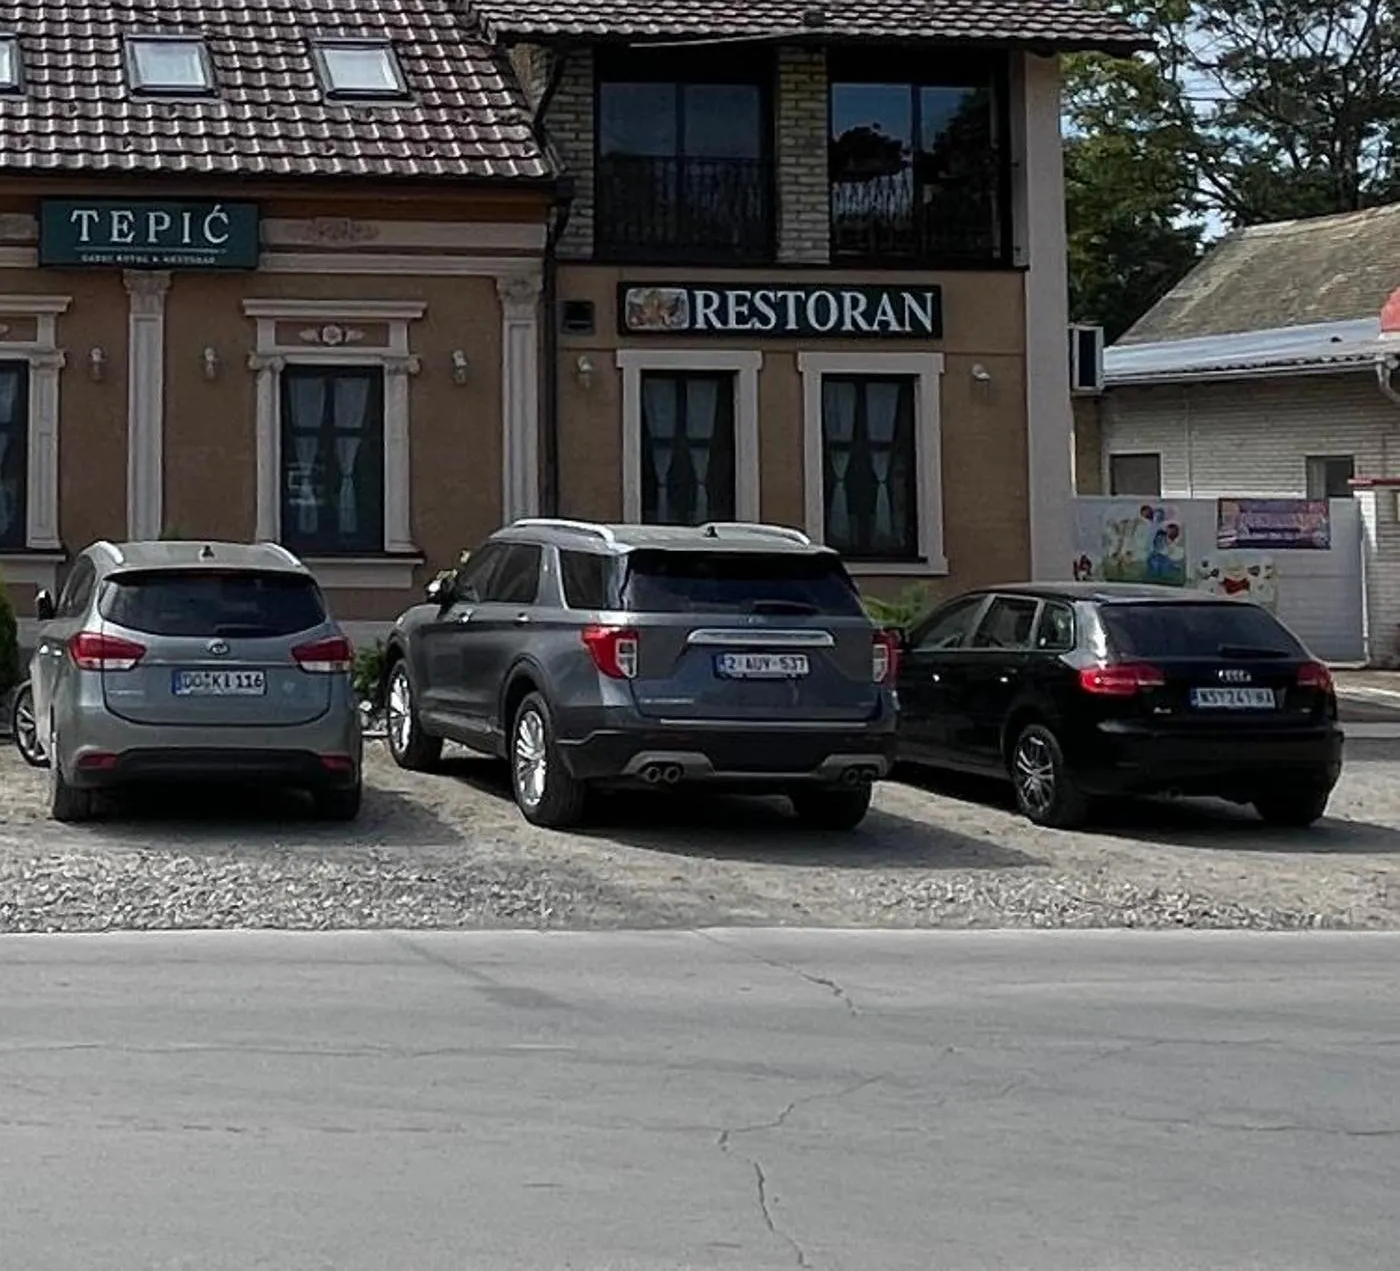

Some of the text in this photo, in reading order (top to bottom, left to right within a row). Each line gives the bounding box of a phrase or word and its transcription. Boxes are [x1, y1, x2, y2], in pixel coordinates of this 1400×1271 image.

[70, 204, 229, 244] TEPIĆ
[693, 290, 934, 333] RESTORAN
[236, 673, 263, 687] 116
